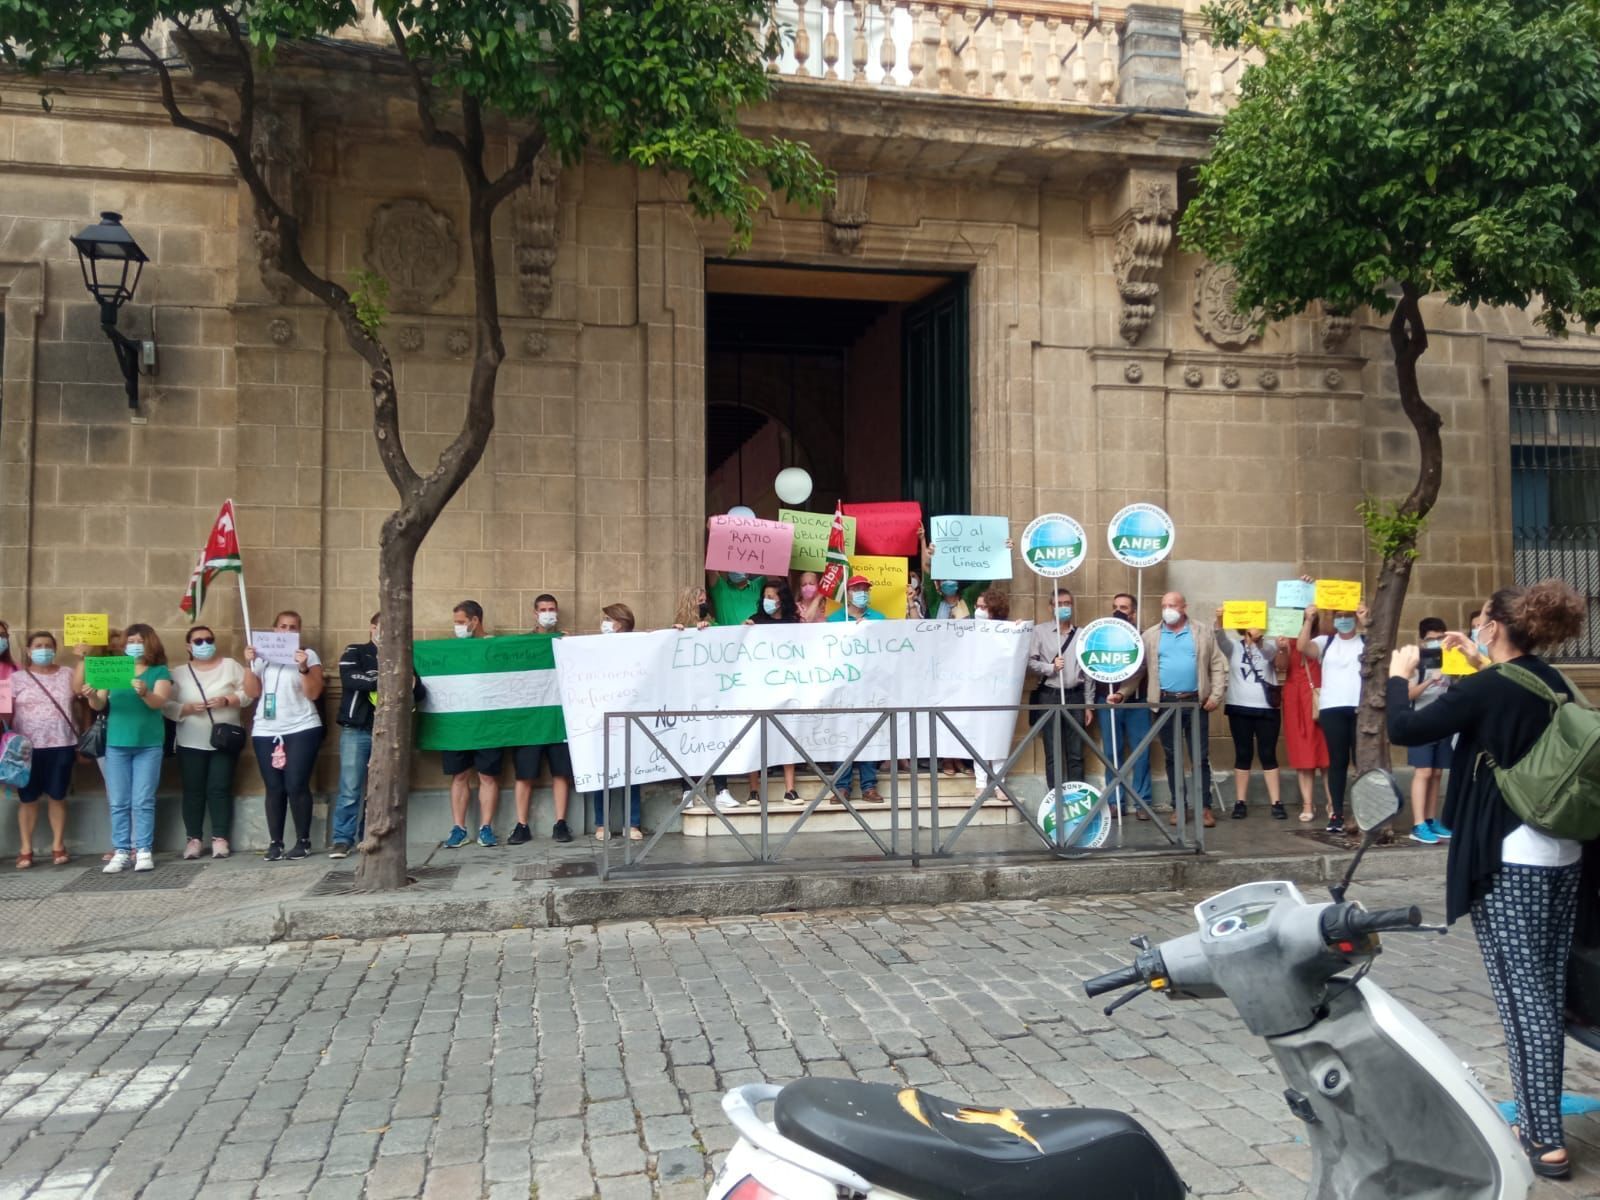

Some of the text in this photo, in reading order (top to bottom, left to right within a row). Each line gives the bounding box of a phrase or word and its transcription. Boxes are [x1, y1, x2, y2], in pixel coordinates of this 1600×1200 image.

[936, 519, 984, 538] NO al
[730, 530, 771, 544] RATIO
[1119, 536, 1161, 550] ANPE
[977, 540, 992, 553] de
[1034, 546, 1075, 561] ANPE
[671, 634, 915, 669] EDUCACIÓN PÚBLICA
[1088, 651, 1131, 665] ANPE
[714, 662, 862, 693] DE CALIDAD
